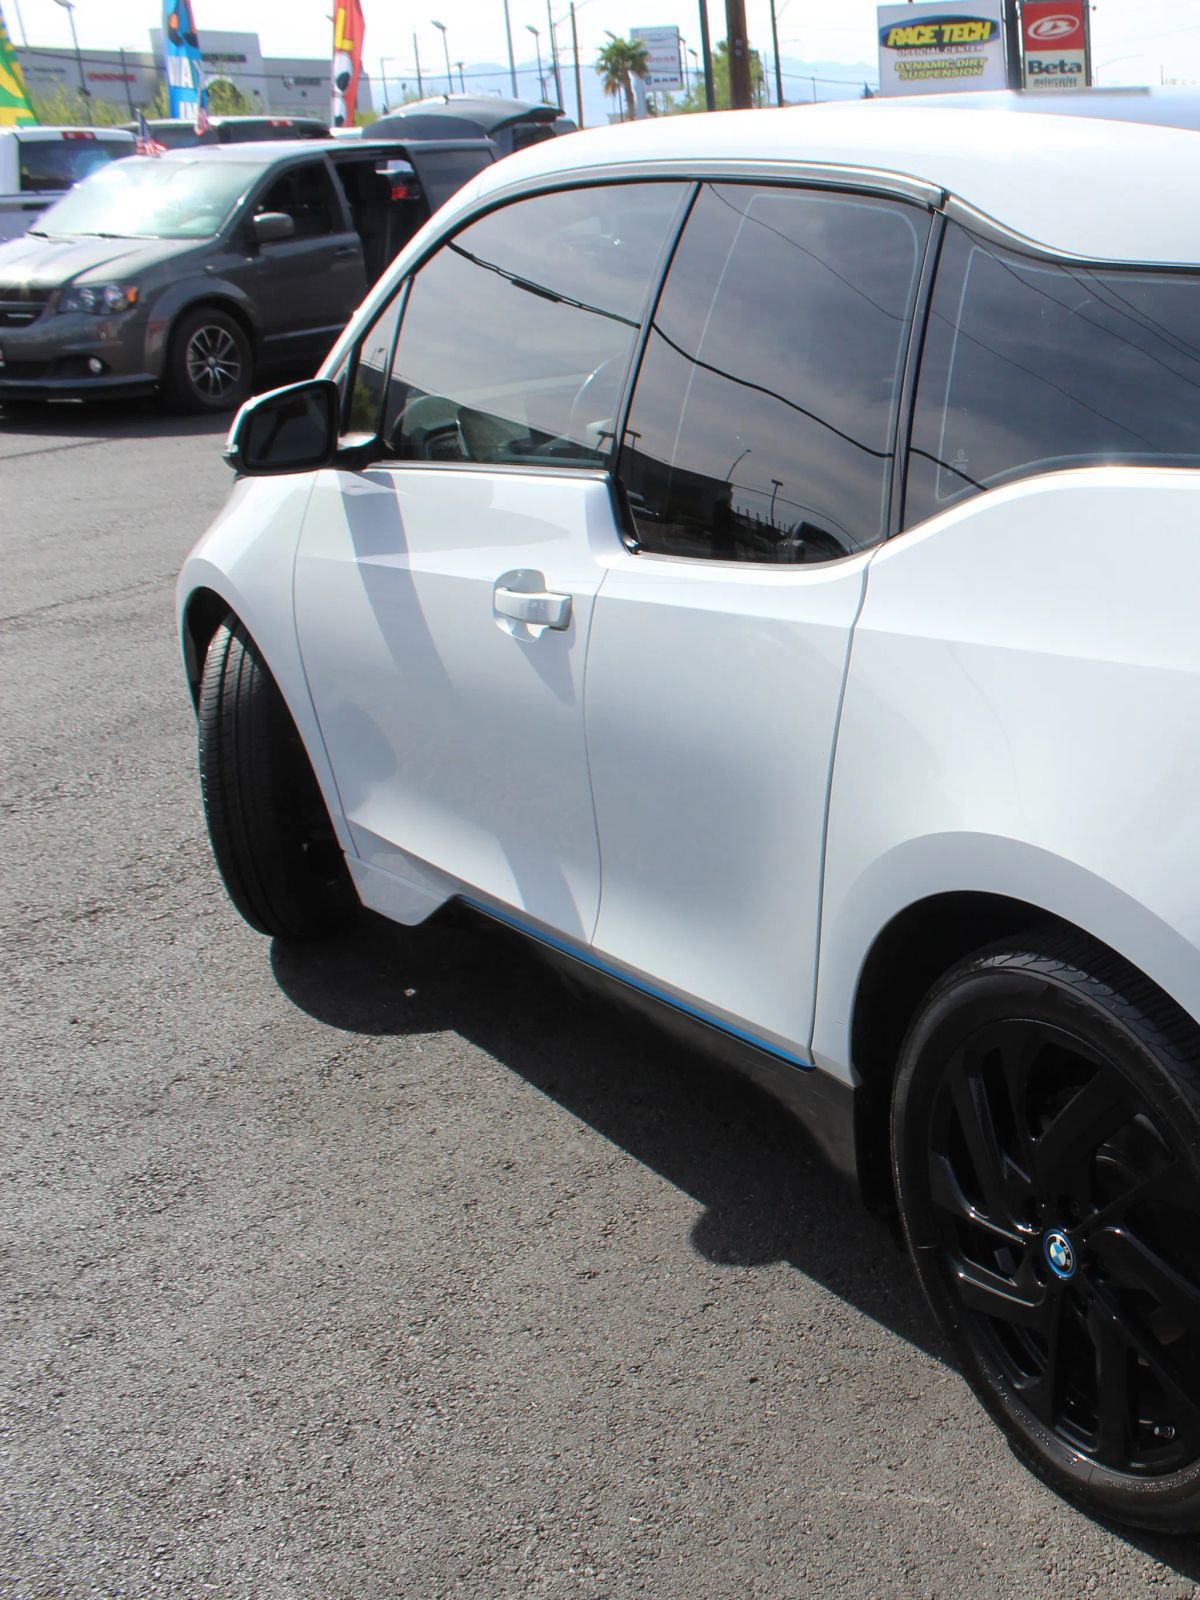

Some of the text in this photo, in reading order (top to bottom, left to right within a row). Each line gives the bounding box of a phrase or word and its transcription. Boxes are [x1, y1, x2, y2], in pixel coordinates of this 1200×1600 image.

[887, 21, 992, 47] RACE TECH
[895, 57, 988, 72] DYNAMIC DIRT
[1028, 59, 1082, 75] Beta
[899, 66, 984, 81] SUSPENSION
